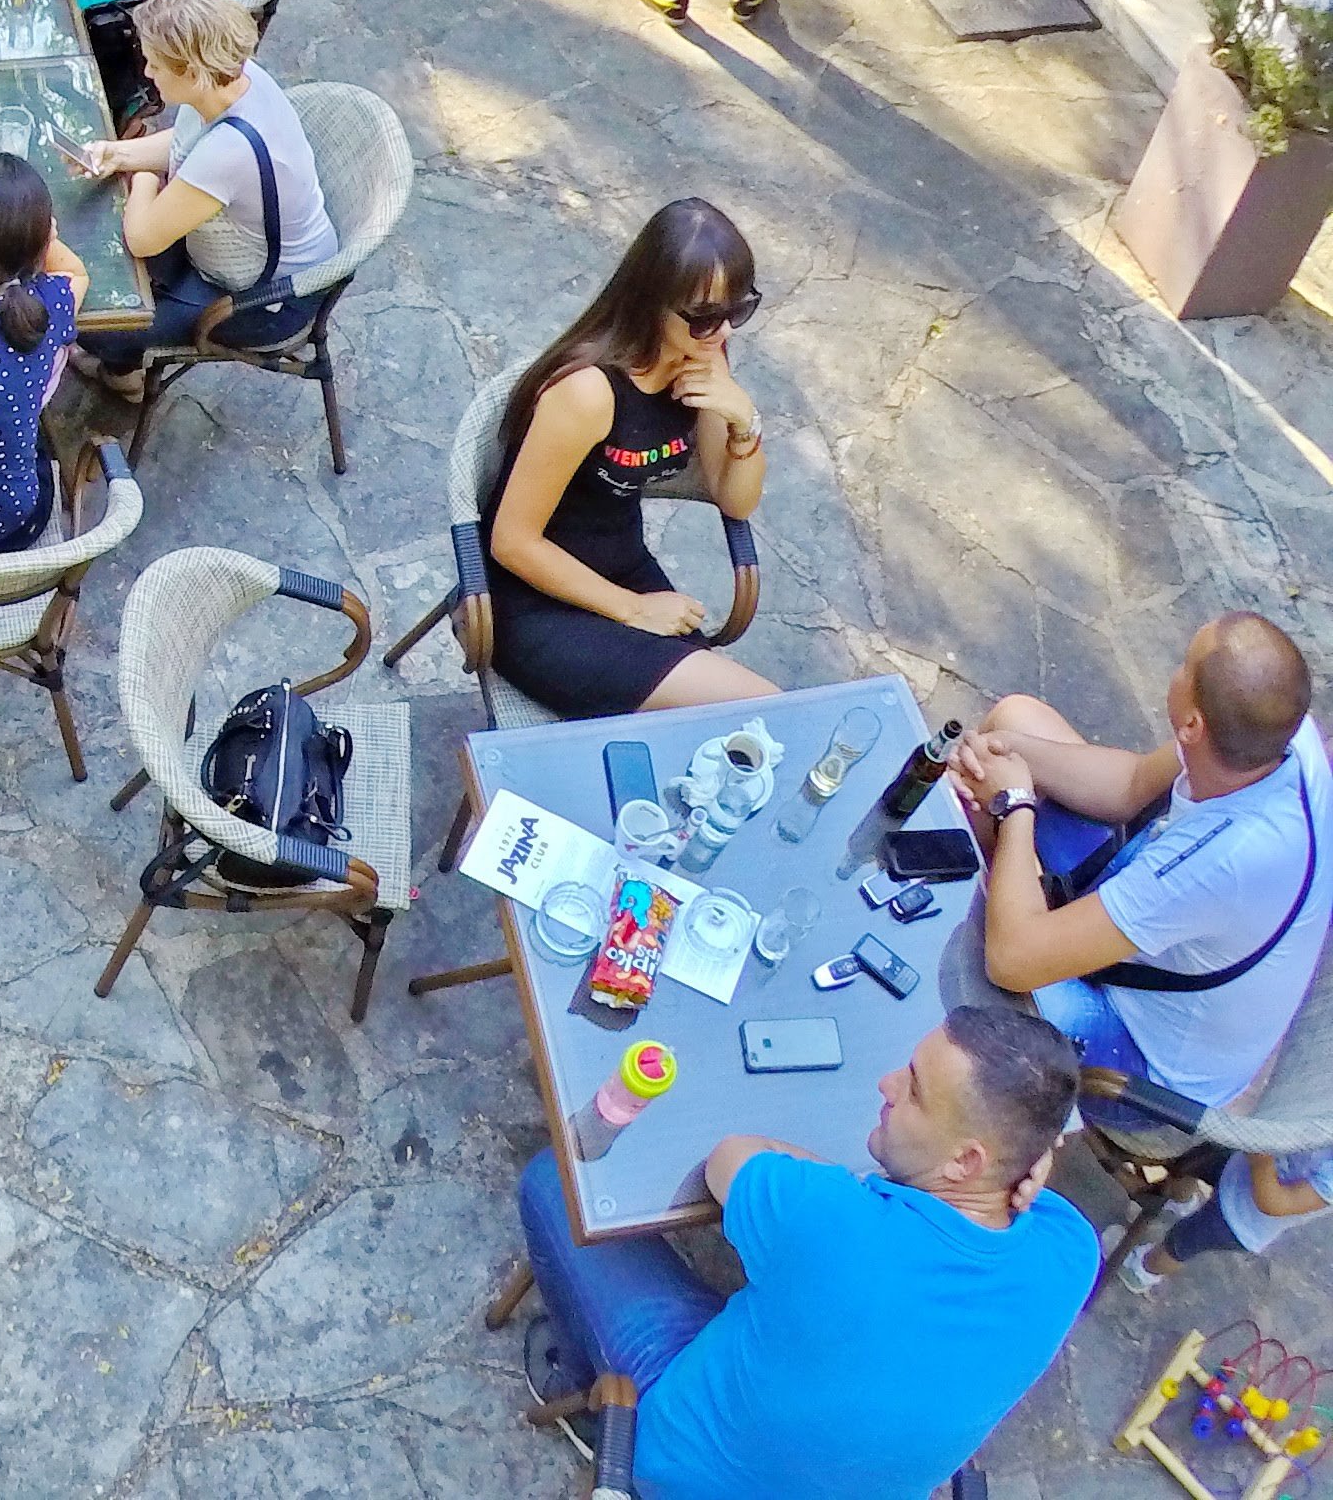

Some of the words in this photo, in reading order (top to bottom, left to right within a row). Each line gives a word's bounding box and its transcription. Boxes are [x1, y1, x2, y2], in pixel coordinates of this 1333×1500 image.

[605, 446, 658, 466] VIENTO
[662, 438, 687, 458] DEL
[497, 818, 539, 884] JAZINA
[531, 842, 548, 869] CLUB
